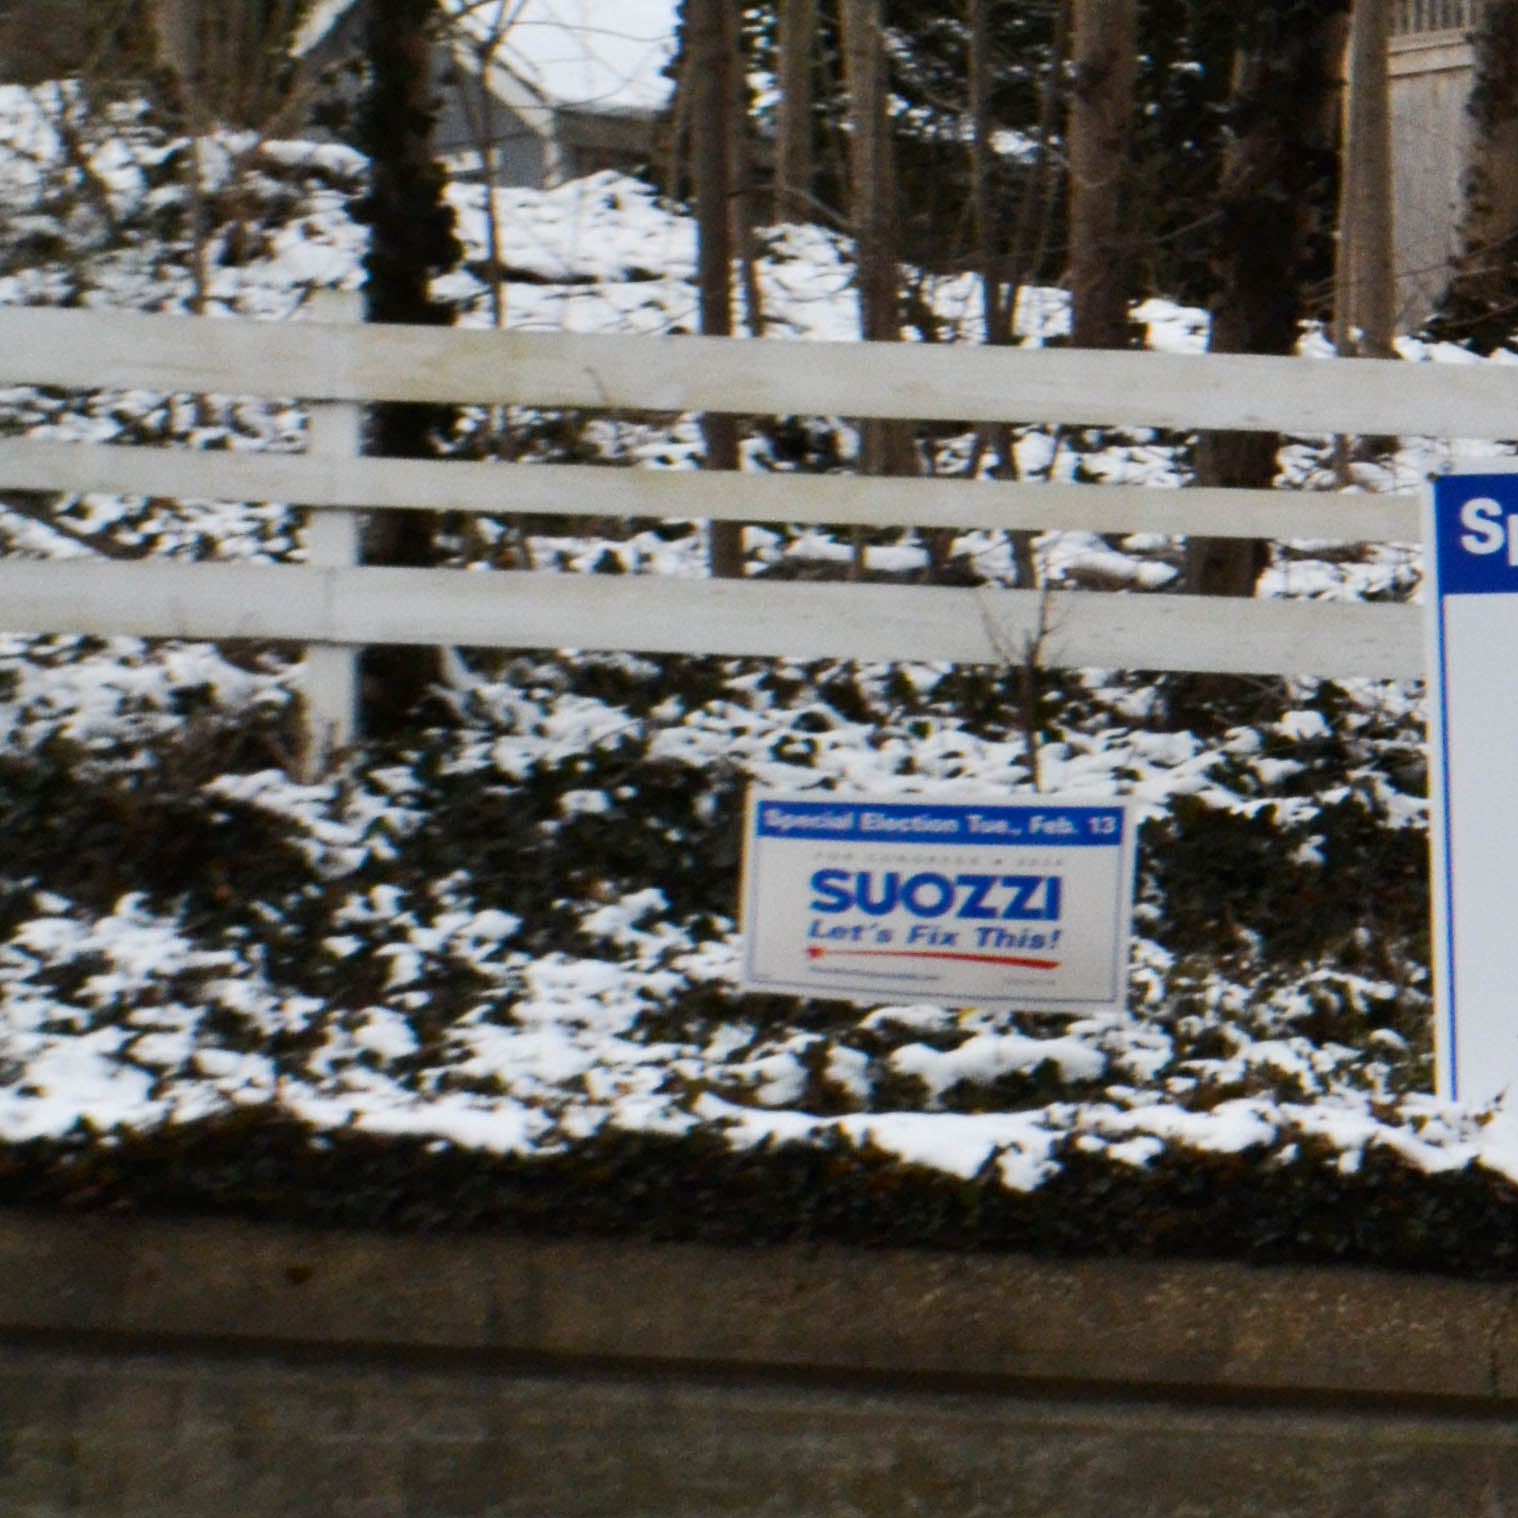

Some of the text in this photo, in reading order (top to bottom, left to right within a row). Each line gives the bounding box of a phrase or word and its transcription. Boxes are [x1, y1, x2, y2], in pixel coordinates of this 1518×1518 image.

[764, 808, 852, 831] Special
[860, 812, 959, 833] Election
[1028, 815, 1079, 834] Feb.
[1088, 815, 1117, 834] 13
[809, 868, 1061, 921] SUOZZI
[808, 919, 1062, 949] Let's Fix This!
